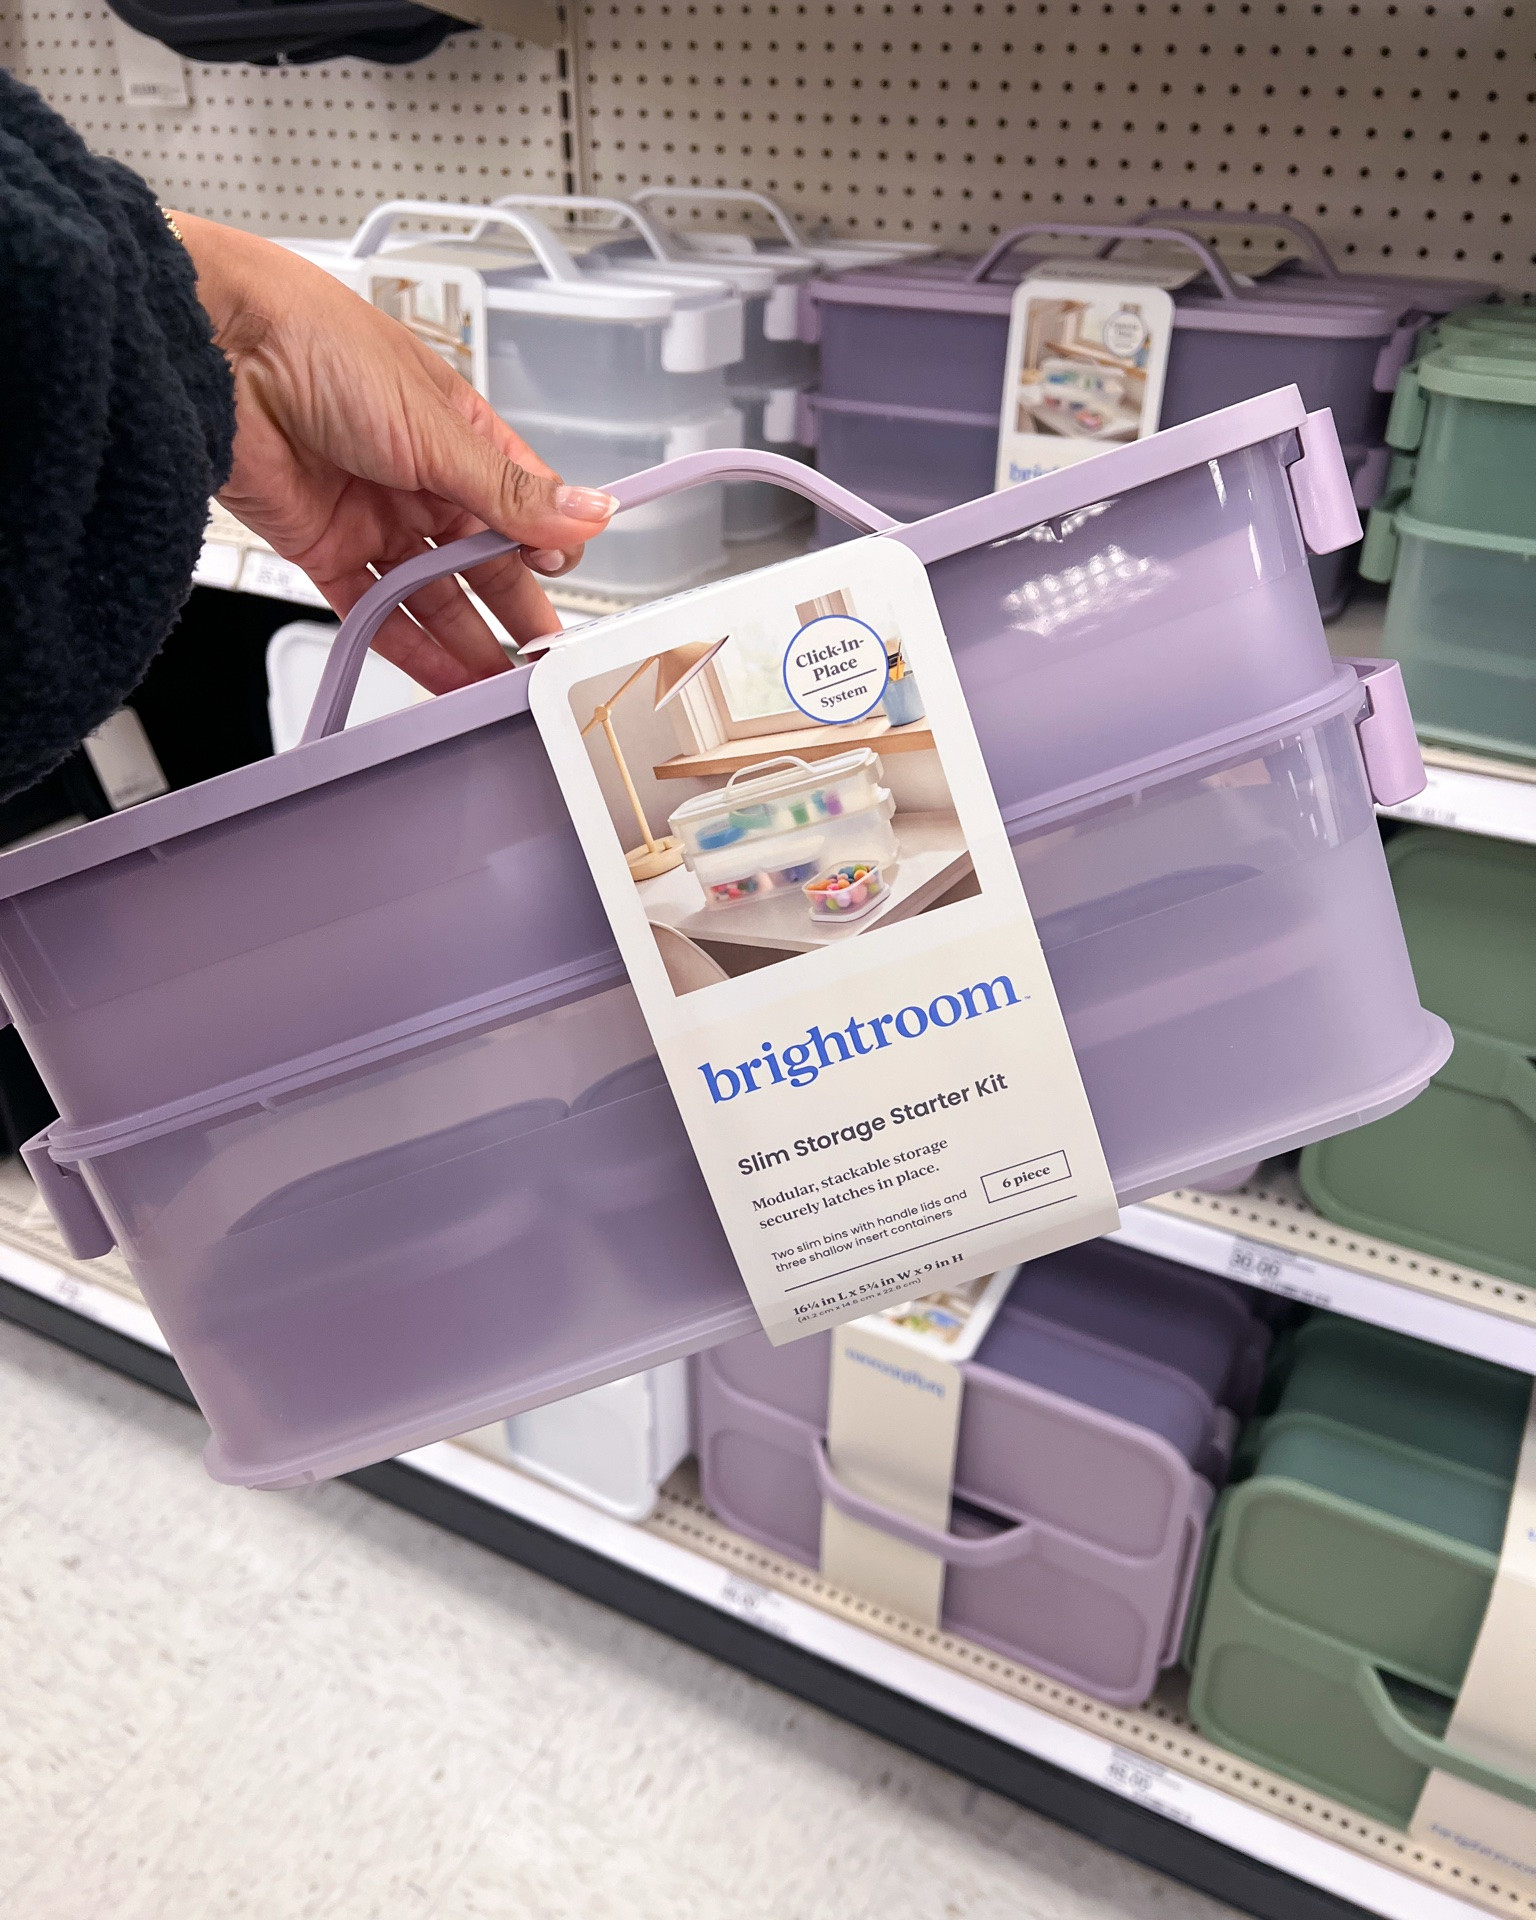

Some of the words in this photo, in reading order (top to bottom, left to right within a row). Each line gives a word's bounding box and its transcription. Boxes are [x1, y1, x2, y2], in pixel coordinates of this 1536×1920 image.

[796, 638, 864, 669] Click-In-
[813, 658, 858, 682] Place
[820, 683, 868, 708] System
[697, 975, 1022, 1104] brightroom
[738, 1149, 790, 1175] Slim
[793, 1117, 886, 1156] Storage
[890, 1087, 969, 1124] Starter
[974, 1073, 1008, 1097] Kit
[752, 1183, 819, 1211] Modular,
[820, 1158, 890, 1188] stackable
[893, 1140, 948, 1164] storage
[759, 1202, 819, 1229] securely
[822, 1184, 875, 1208] latches
[877, 1178, 893, 1190] in
[895, 1164, 939, 1186] place.
[1002, 1178, 1011, 1188] 6
[1013, 1167, 1050, 1187] piece
[770, 1248, 794, 1260] Two
[796, 1239, 821, 1252] slim
[822, 1230, 848, 1244] bins
[850, 1221, 875, 1234] with
[876, 1207, 918, 1226] handle
[920, 1200, 941, 1212] lids
[943, 1189, 967, 1204] and
[775, 1257, 806, 1272] three
[809, 1241, 852, 1261] shallow
[854, 1229, 889, 1246] insert
[890, 1209, 953, 1234] containers
[821, 1297, 836, 1306] in
[838, 1292, 847, 1300] L
[848, 1289, 857, 1297] x
[880, 1277, 895, 1286] in
[897, 1270, 912, 1280] W
[923, 1263, 932, 1271] 9
[935, 1259, 950, 1268] in
[951, 1253, 963, 1263] H
